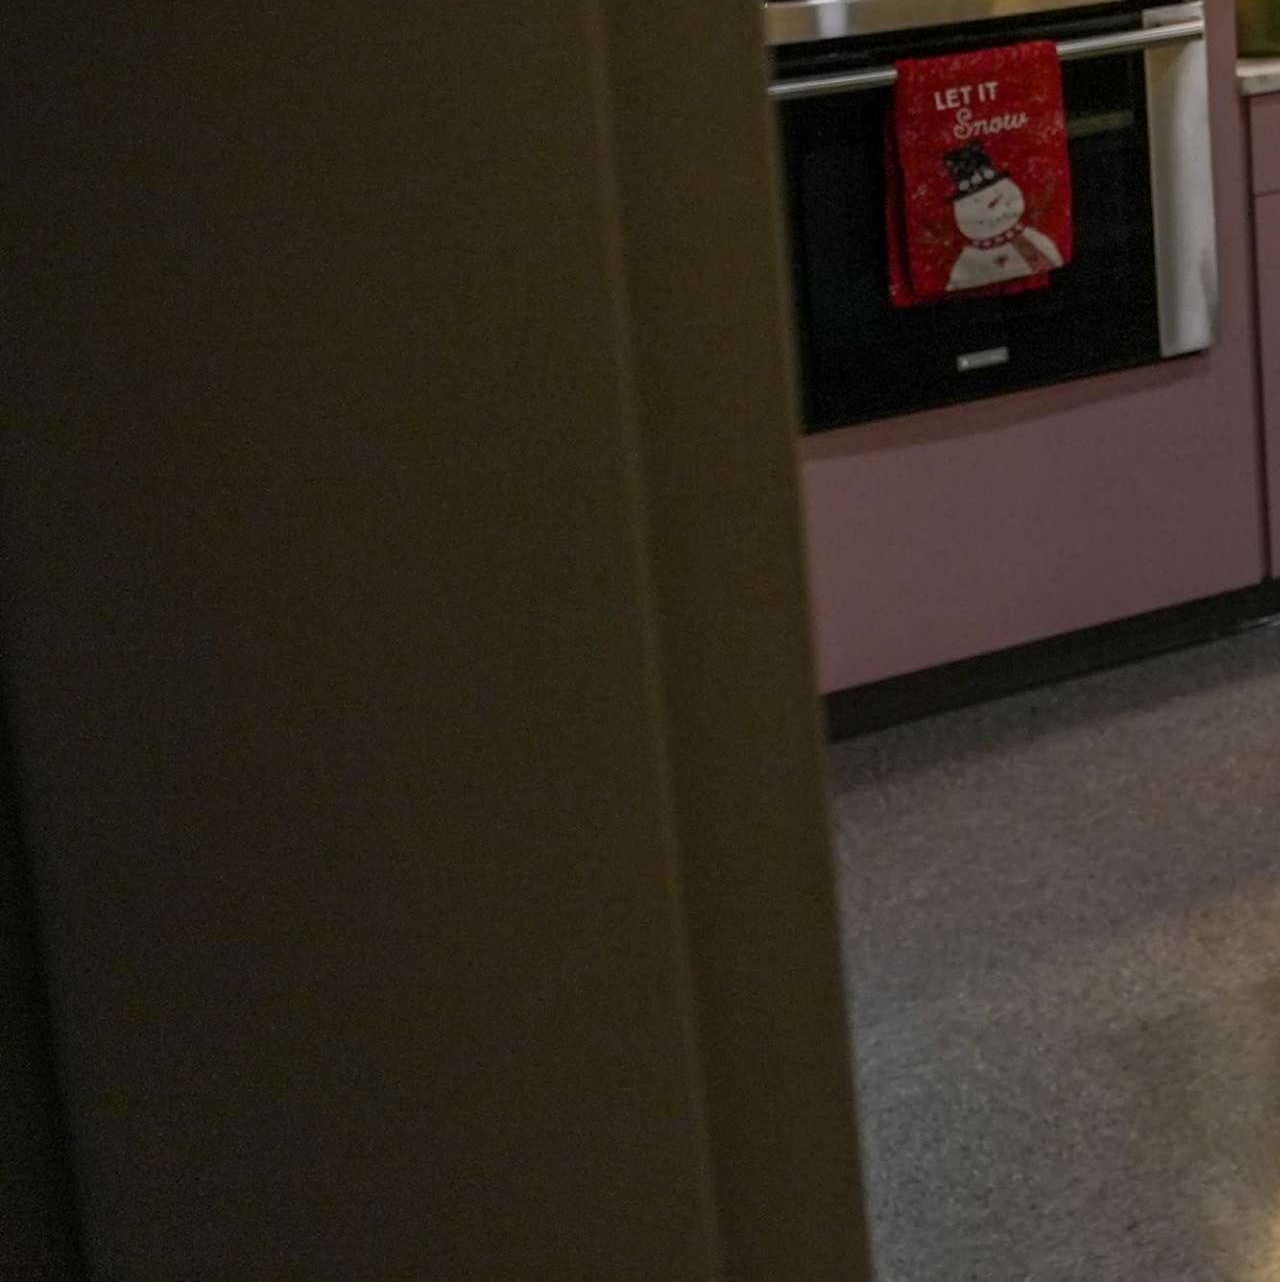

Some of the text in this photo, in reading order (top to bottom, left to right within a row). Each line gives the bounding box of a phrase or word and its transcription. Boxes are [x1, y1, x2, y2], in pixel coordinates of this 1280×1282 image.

[934, 81, 998, 110] LET IT
[953, 107, 1029, 139] Snow
